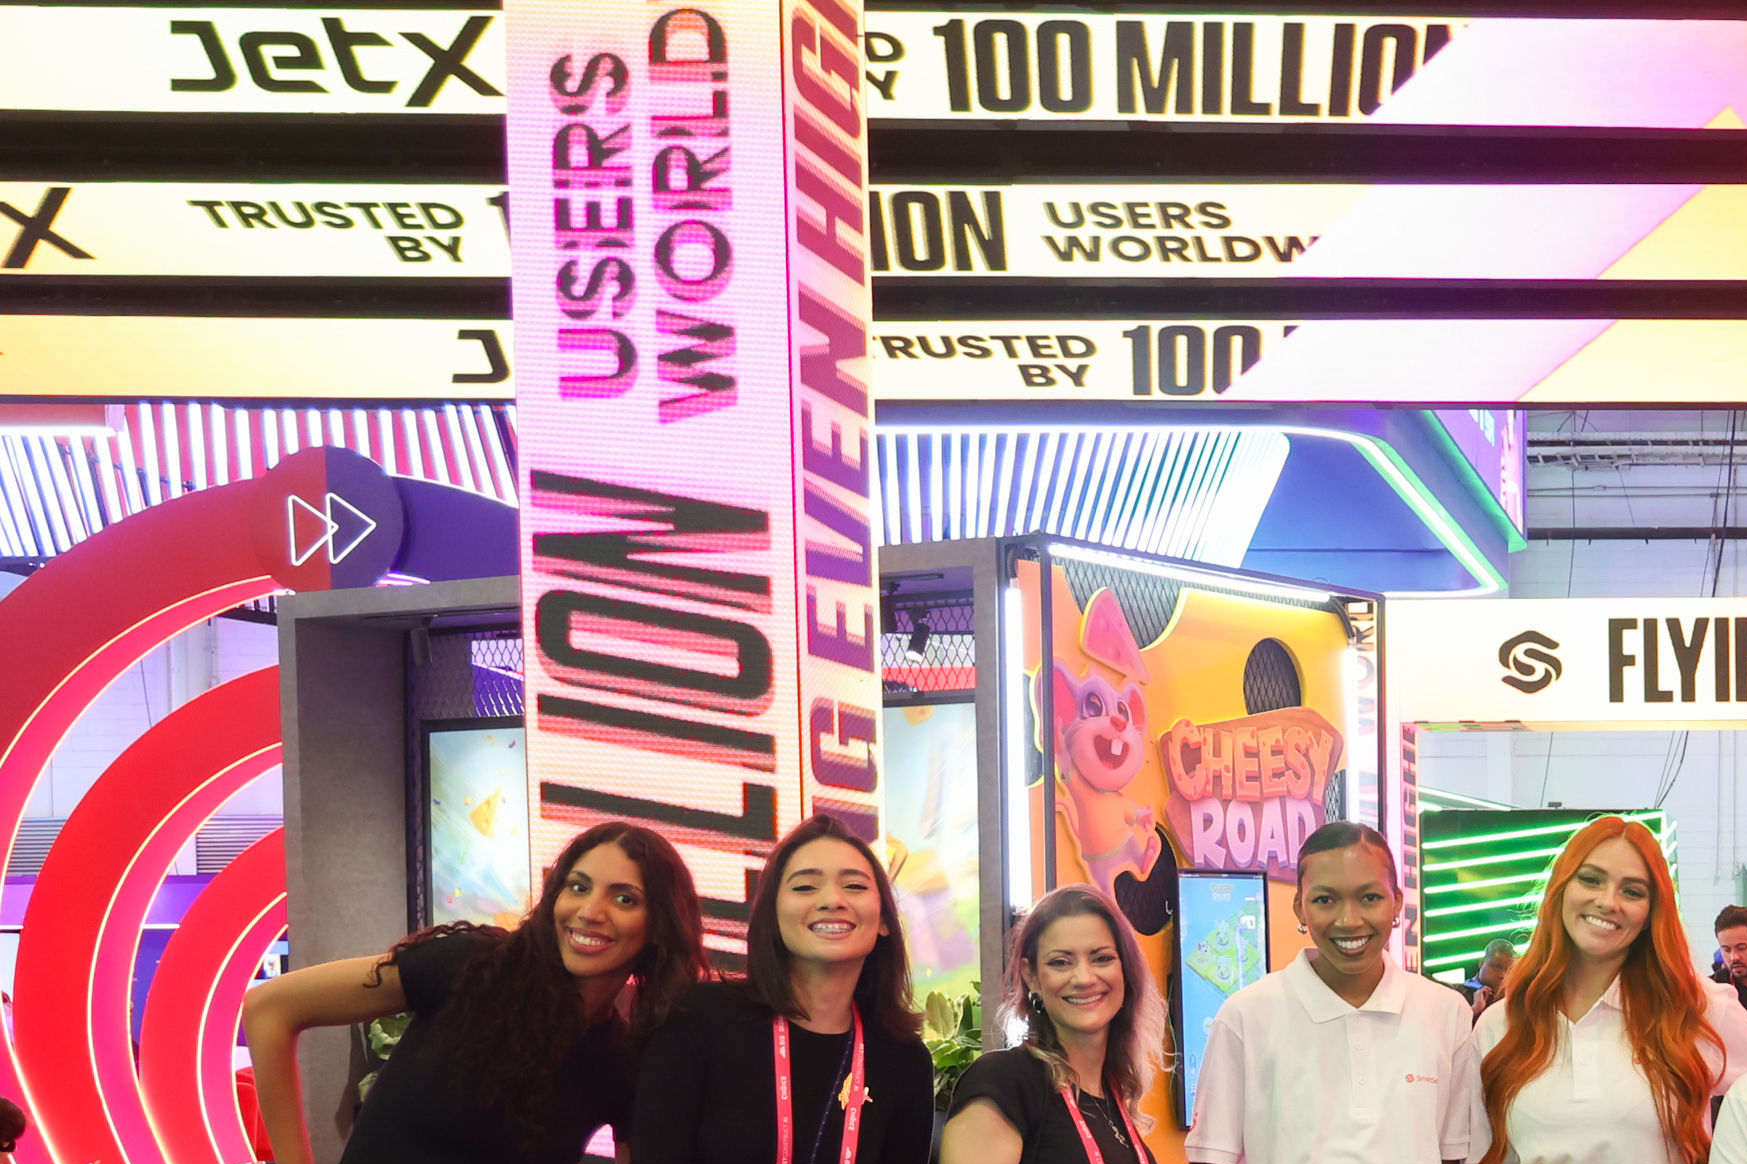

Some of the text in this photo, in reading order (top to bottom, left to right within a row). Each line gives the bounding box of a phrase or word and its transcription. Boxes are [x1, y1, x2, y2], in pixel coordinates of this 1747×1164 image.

[170, 15, 505, 107] JetX
[933, 18, 1467, 117] 100 MILLIO
[190, 200, 464, 231] TRUSTED
[388, 236, 465, 264] BY
[549, 52, 639, 400] USERS
[647, 7, 739, 424] WORLD
[1041, 234, 1321, 264] WORLDW
[1042, 200, 1232, 231] USERS
[868, 335, 1097, 360] RUSTED
[1018, 364, 1091, 388] BY
[798, 281, 876, 674] EVEN
[1168, 719, 1334, 806] CHEESY
[1190, 796, 1317, 871] ROAD
